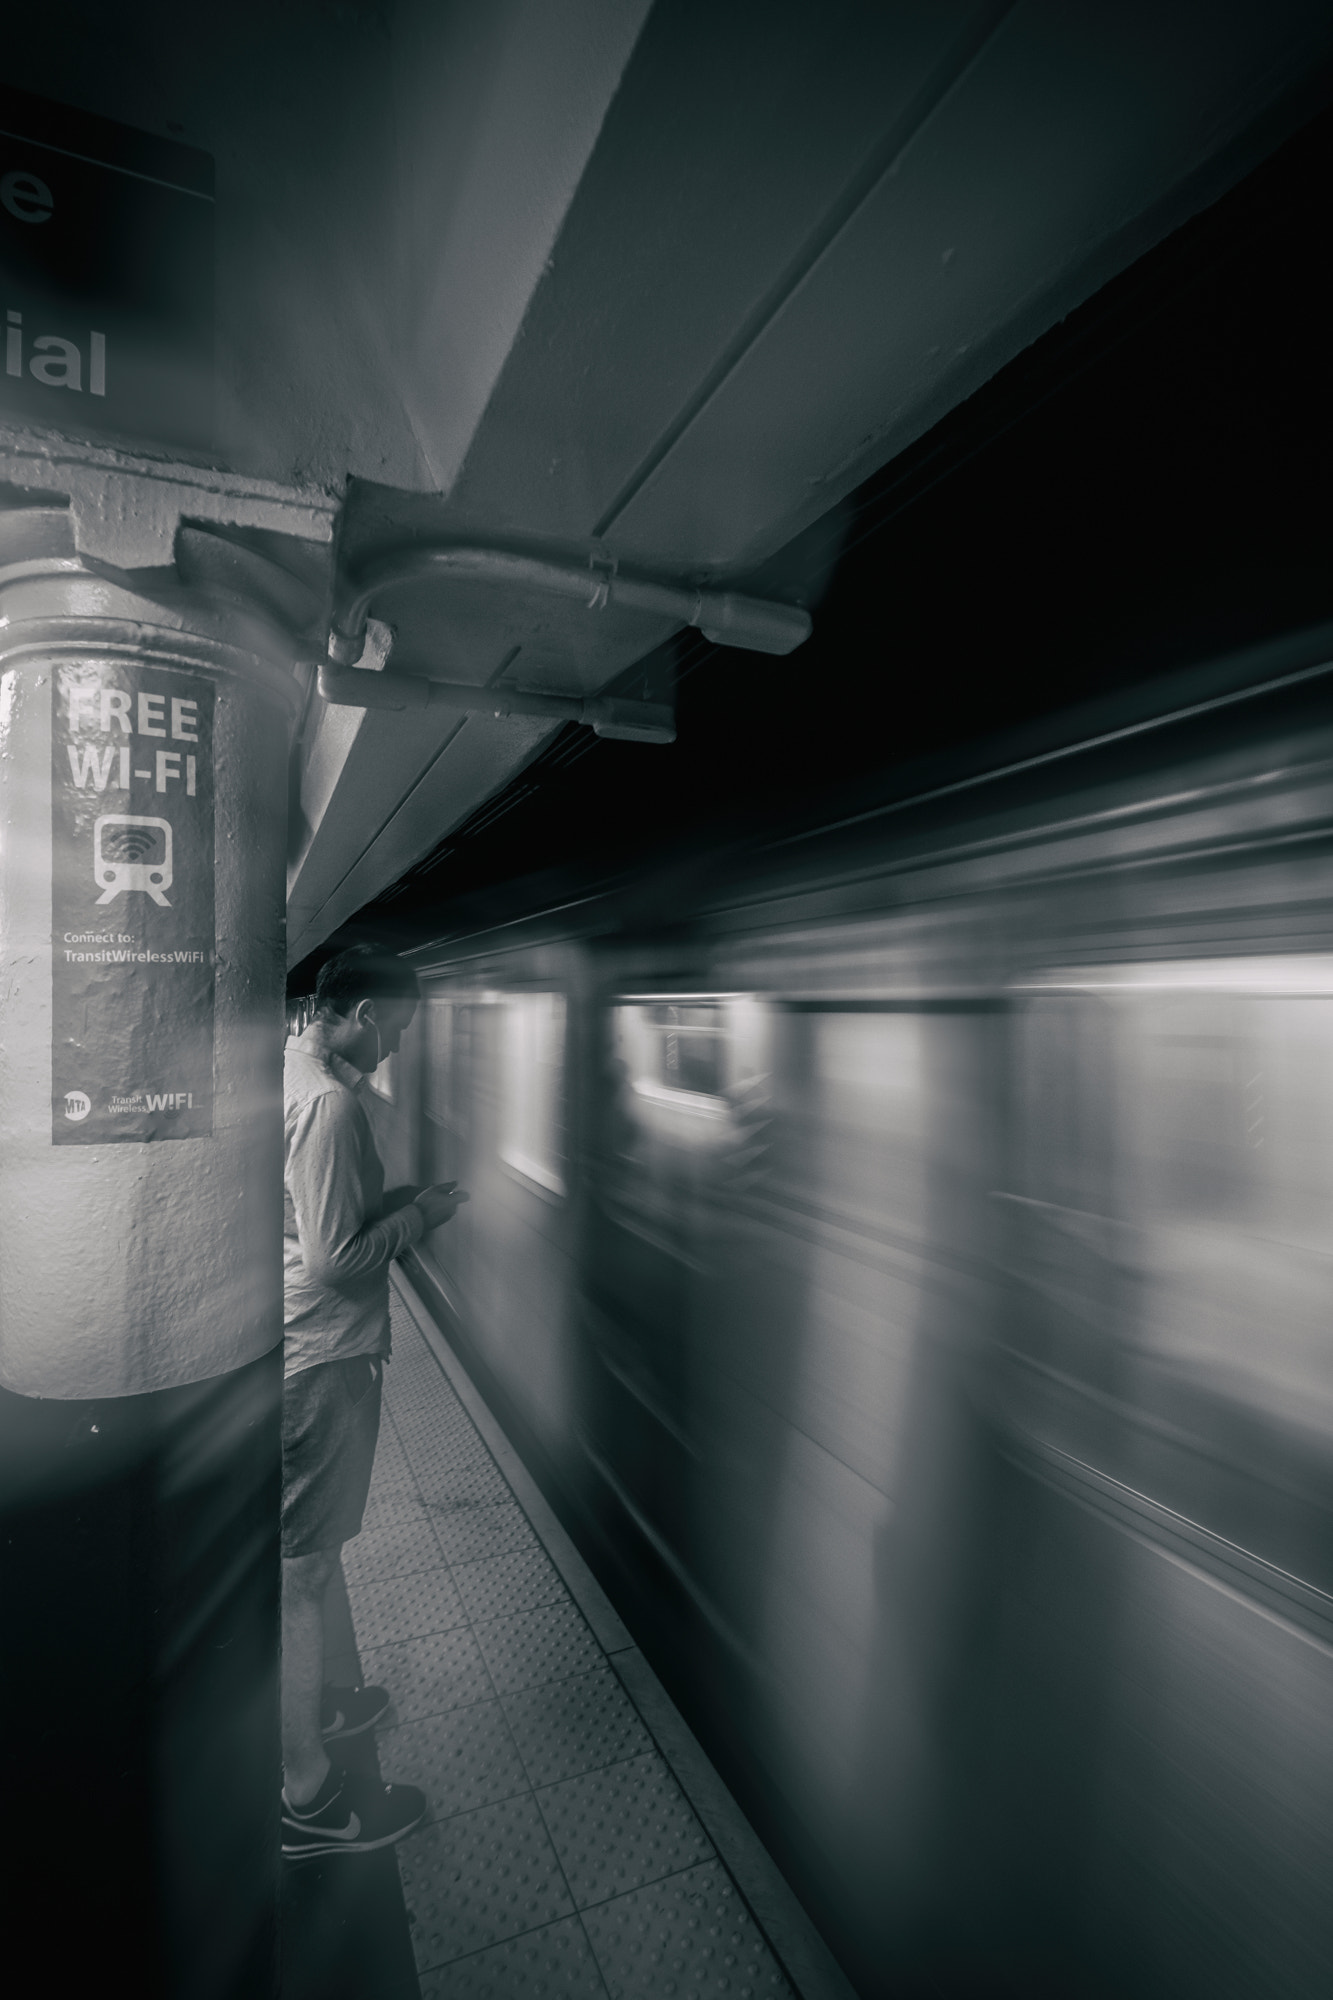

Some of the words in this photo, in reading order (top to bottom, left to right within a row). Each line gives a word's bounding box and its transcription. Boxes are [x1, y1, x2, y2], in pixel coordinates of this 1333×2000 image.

[6, 309, 106, 397] ial
[69, 687, 199, 742] FREE
[66, 745, 196, 796] WI-FI
[64, 932, 114, 943] Connect
[117, 933, 135, 943] to:
[64, 950, 204, 963] TransitWirelessWiFi
[64, 1096, 87, 1116] MTA
[112, 1095, 142, 1104] Transit
[108, 1104, 147, 1113] Wireless
